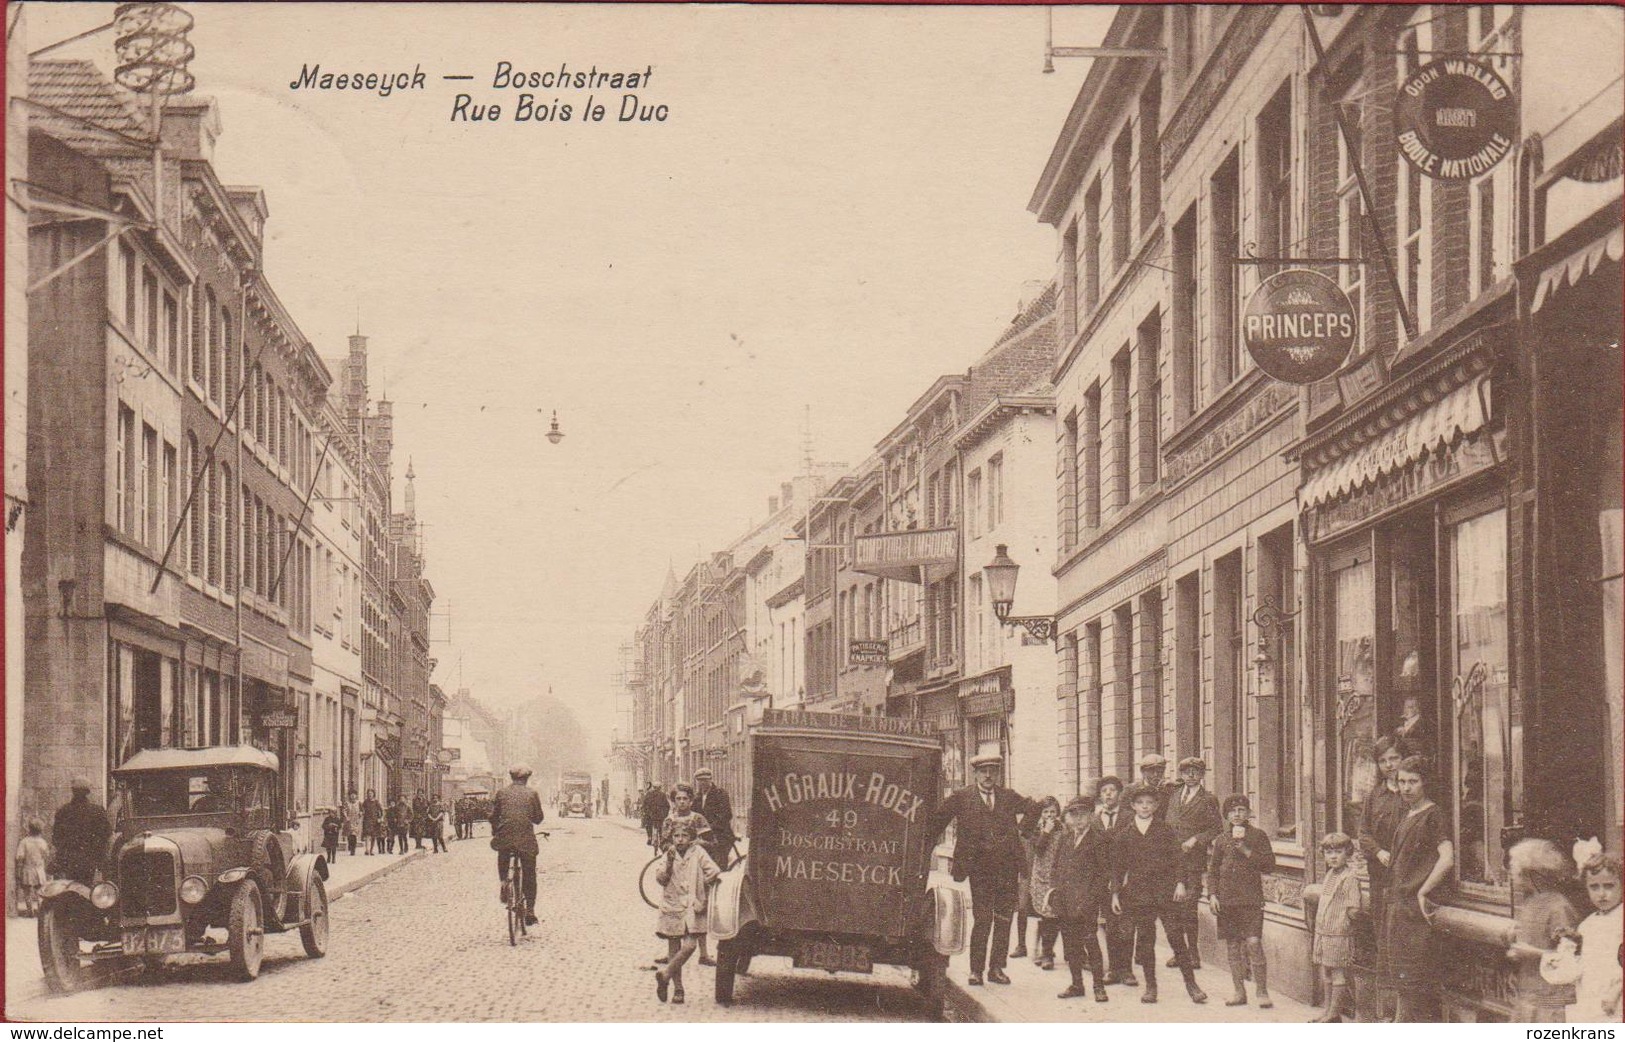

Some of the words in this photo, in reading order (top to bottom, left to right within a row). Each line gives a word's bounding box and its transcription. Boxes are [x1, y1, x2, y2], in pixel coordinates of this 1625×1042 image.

[1398, 130, 1439, 173] BOULE
[1440, 133, 1511, 178] NATIONALE
[1246, 312, 1353, 341] PRINCEPS
[830, 713, 848, 729] DE
[784, 772, 923, 823] GRAUX-ROEX
[780, 828, 899, 854] BOSCHSTRAAT
[775, 855, 902, 886] MAESEYCK
